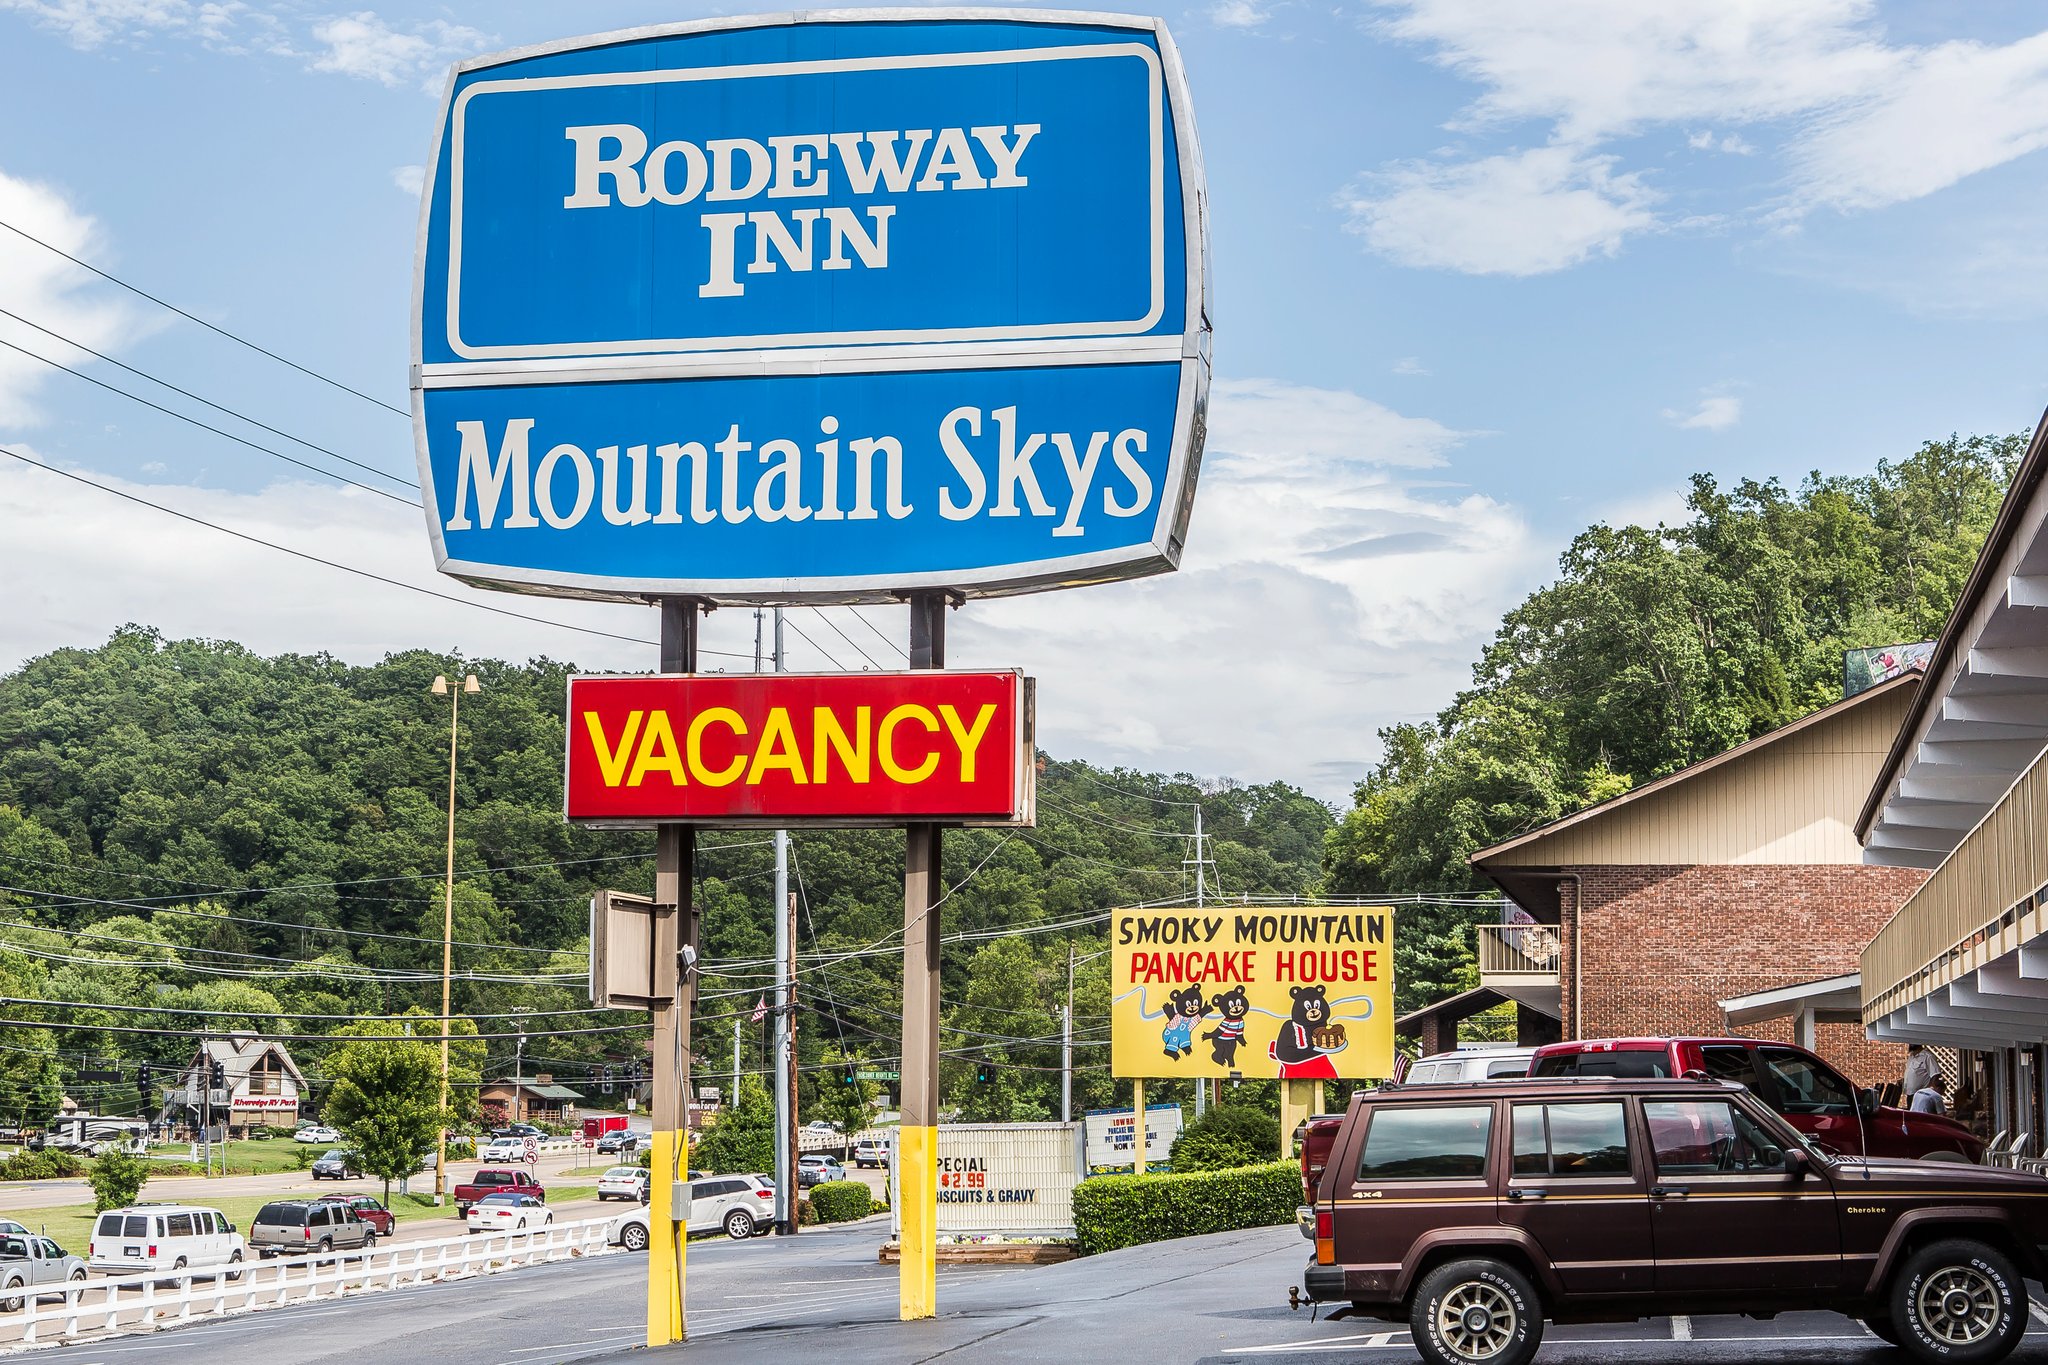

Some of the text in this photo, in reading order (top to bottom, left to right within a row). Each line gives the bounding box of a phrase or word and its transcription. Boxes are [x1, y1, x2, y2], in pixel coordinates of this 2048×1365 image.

[564, 123, 1041, 210] RODEWAY
[698, 205, 896, 298] INN
[445, 405, 1153, 538] Mountain Skys
[583, 703, 998, 787] VACANCY
[1118, 914, 1385, 946] SMOKY MOUNTAIN
[1130, 950, 1378, 984] PANCAKE HOUSE
[234, 1099, 268, 1108] Riveredge
[1105, 1135, 1114, 1143] PET
[1115, 1133, 1133, 1142] ROOMS
[1113, 1118, 1125, 1127] LOW
[937, 1157, 987, 1172] PECIAL
[941, 1173, 985, 1188] $2.99
[986, 1189, 995, 1203] &
[998, 1189, 1035, 1203] GRAVY
[1847, 1206, 1886, 1214] Cherokee
[1480, 1271, 1525, 1311] COURSER
[1970, 1258, 2012, 1336] COURSER A/T
[1427, 1297, 1477, 1365] ASTERCRAFT
[1907, 1274, 1950, 1354] MASTERCRAFT
